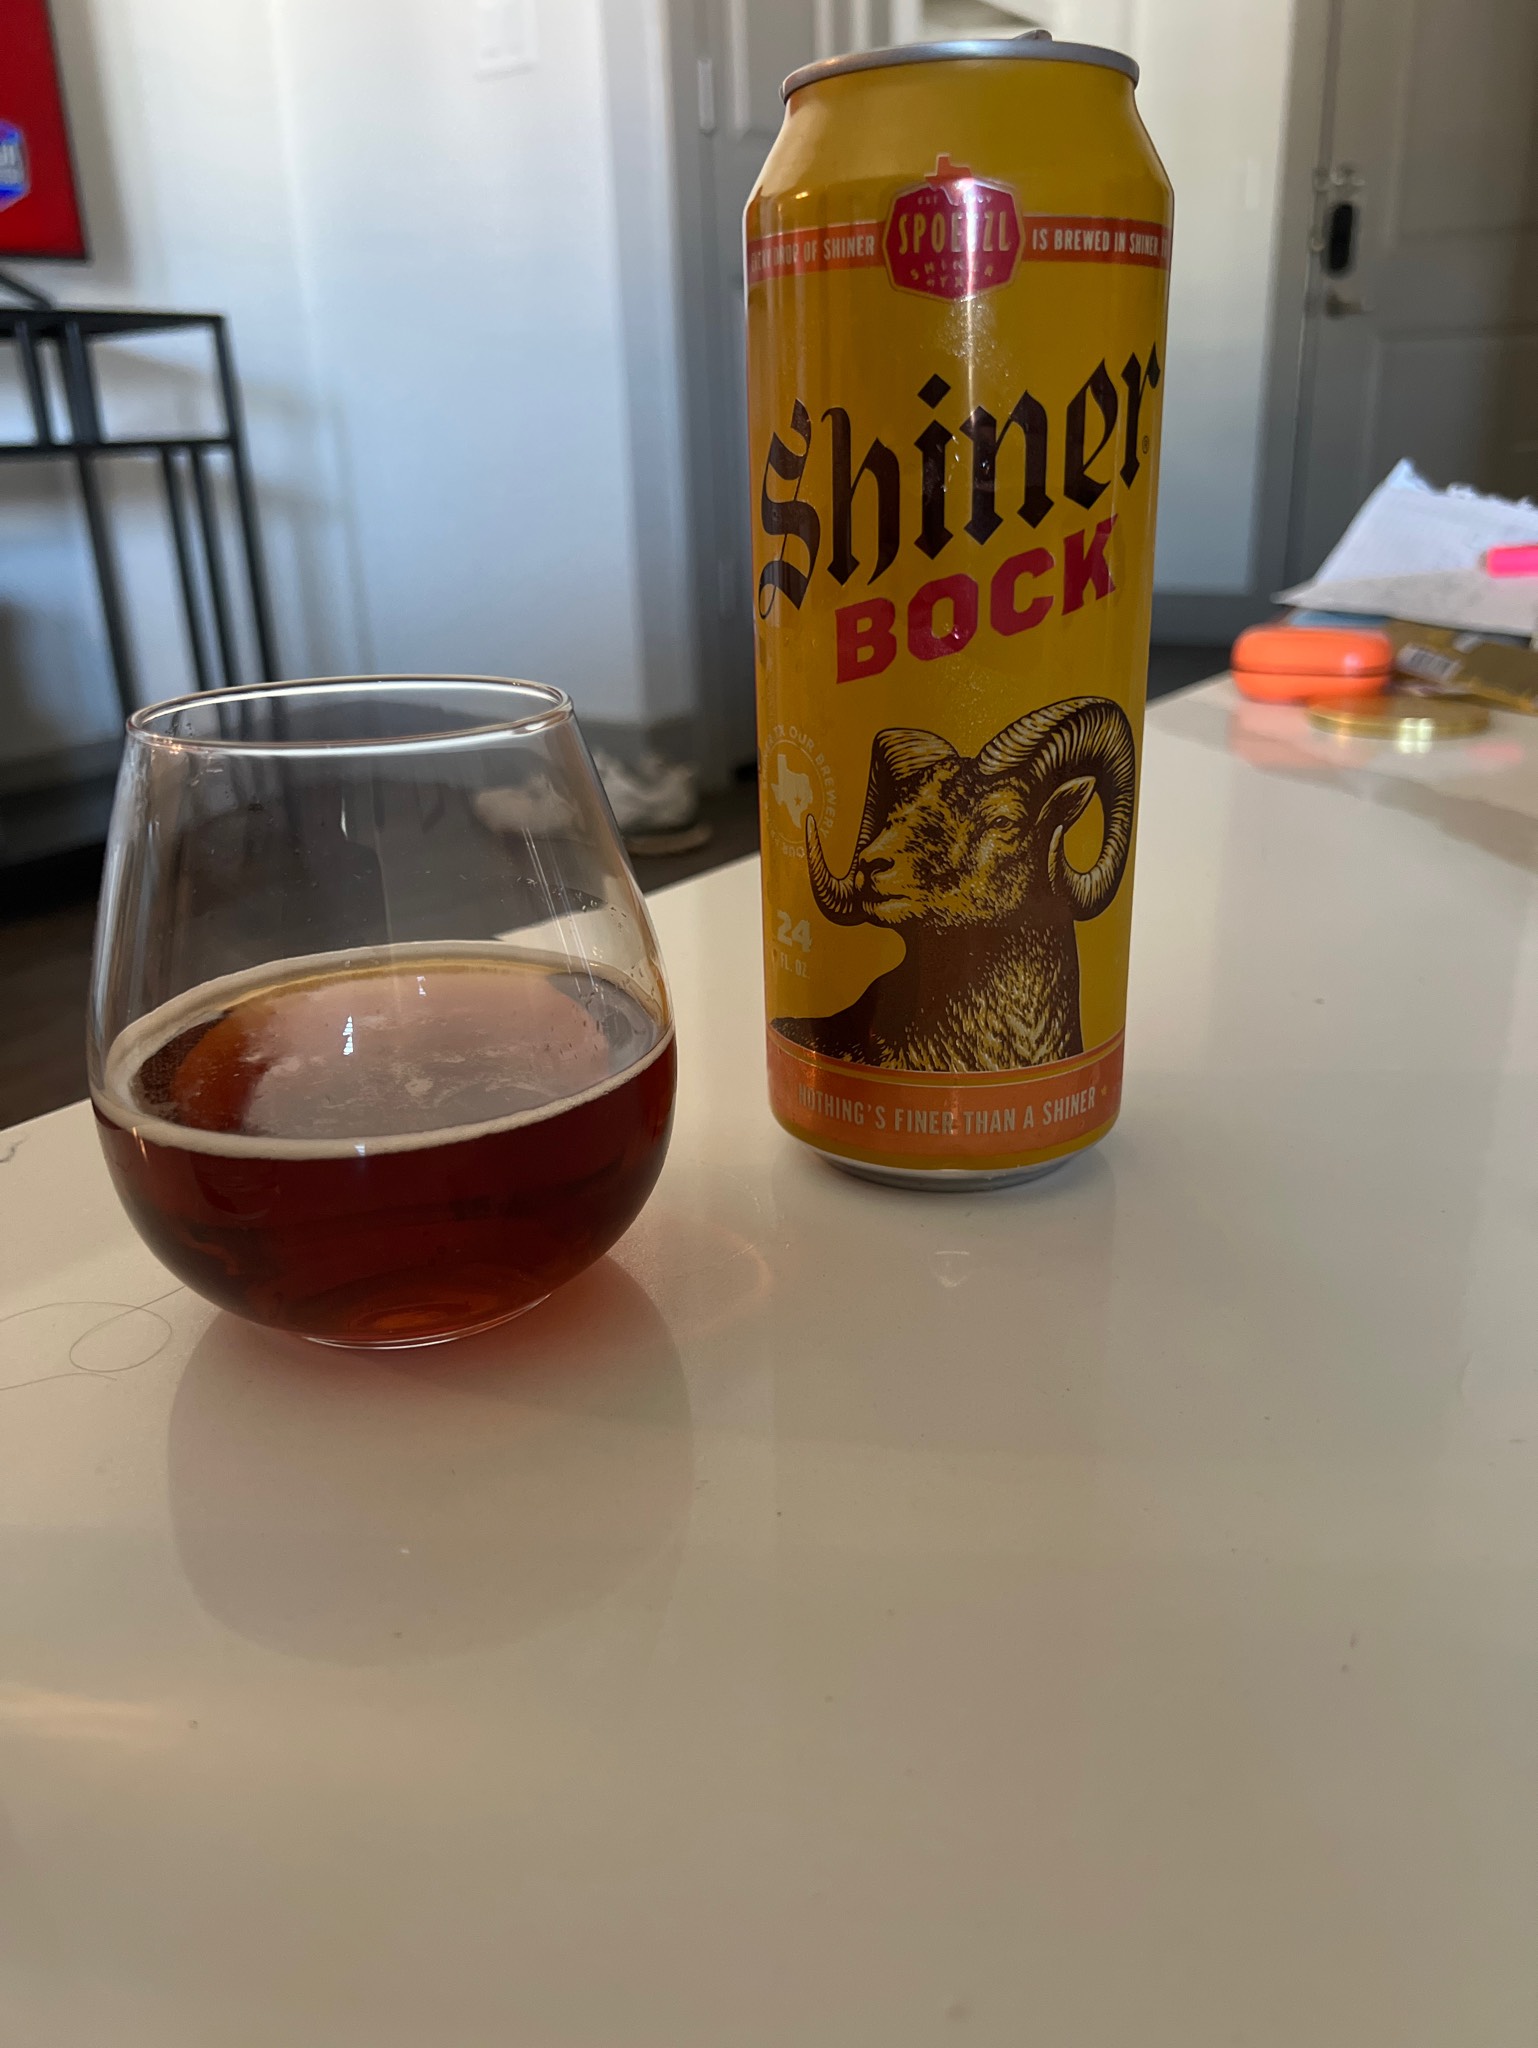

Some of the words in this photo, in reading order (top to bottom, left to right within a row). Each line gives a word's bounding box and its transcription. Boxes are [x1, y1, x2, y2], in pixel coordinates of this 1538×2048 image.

[803, 240, 817, 263] OF
[823, 235, 875, 261] SHINER
[1032, 228, 1048, 251] IS
[1053, 228, 1110, 252] BREWED
[1114, 231, 1126, 253] IN
[758, 342, 1161, 620] Shiner
[834, 513, 1119, 684] BOCK
[788, 726, 815, 750] OUR
[815, 753, 837, 839] BREWERY
[776, 908, 813, 953] 24
[799, 1083, 886, 1129] NOTHING'S
[894, 1108, 953, 1135] FINER
[963, 1107, 1016, 1135] THAN
[1023, 1105, 1034, 1129] A
[1042, 1086, 1096, 1126] SHINER
